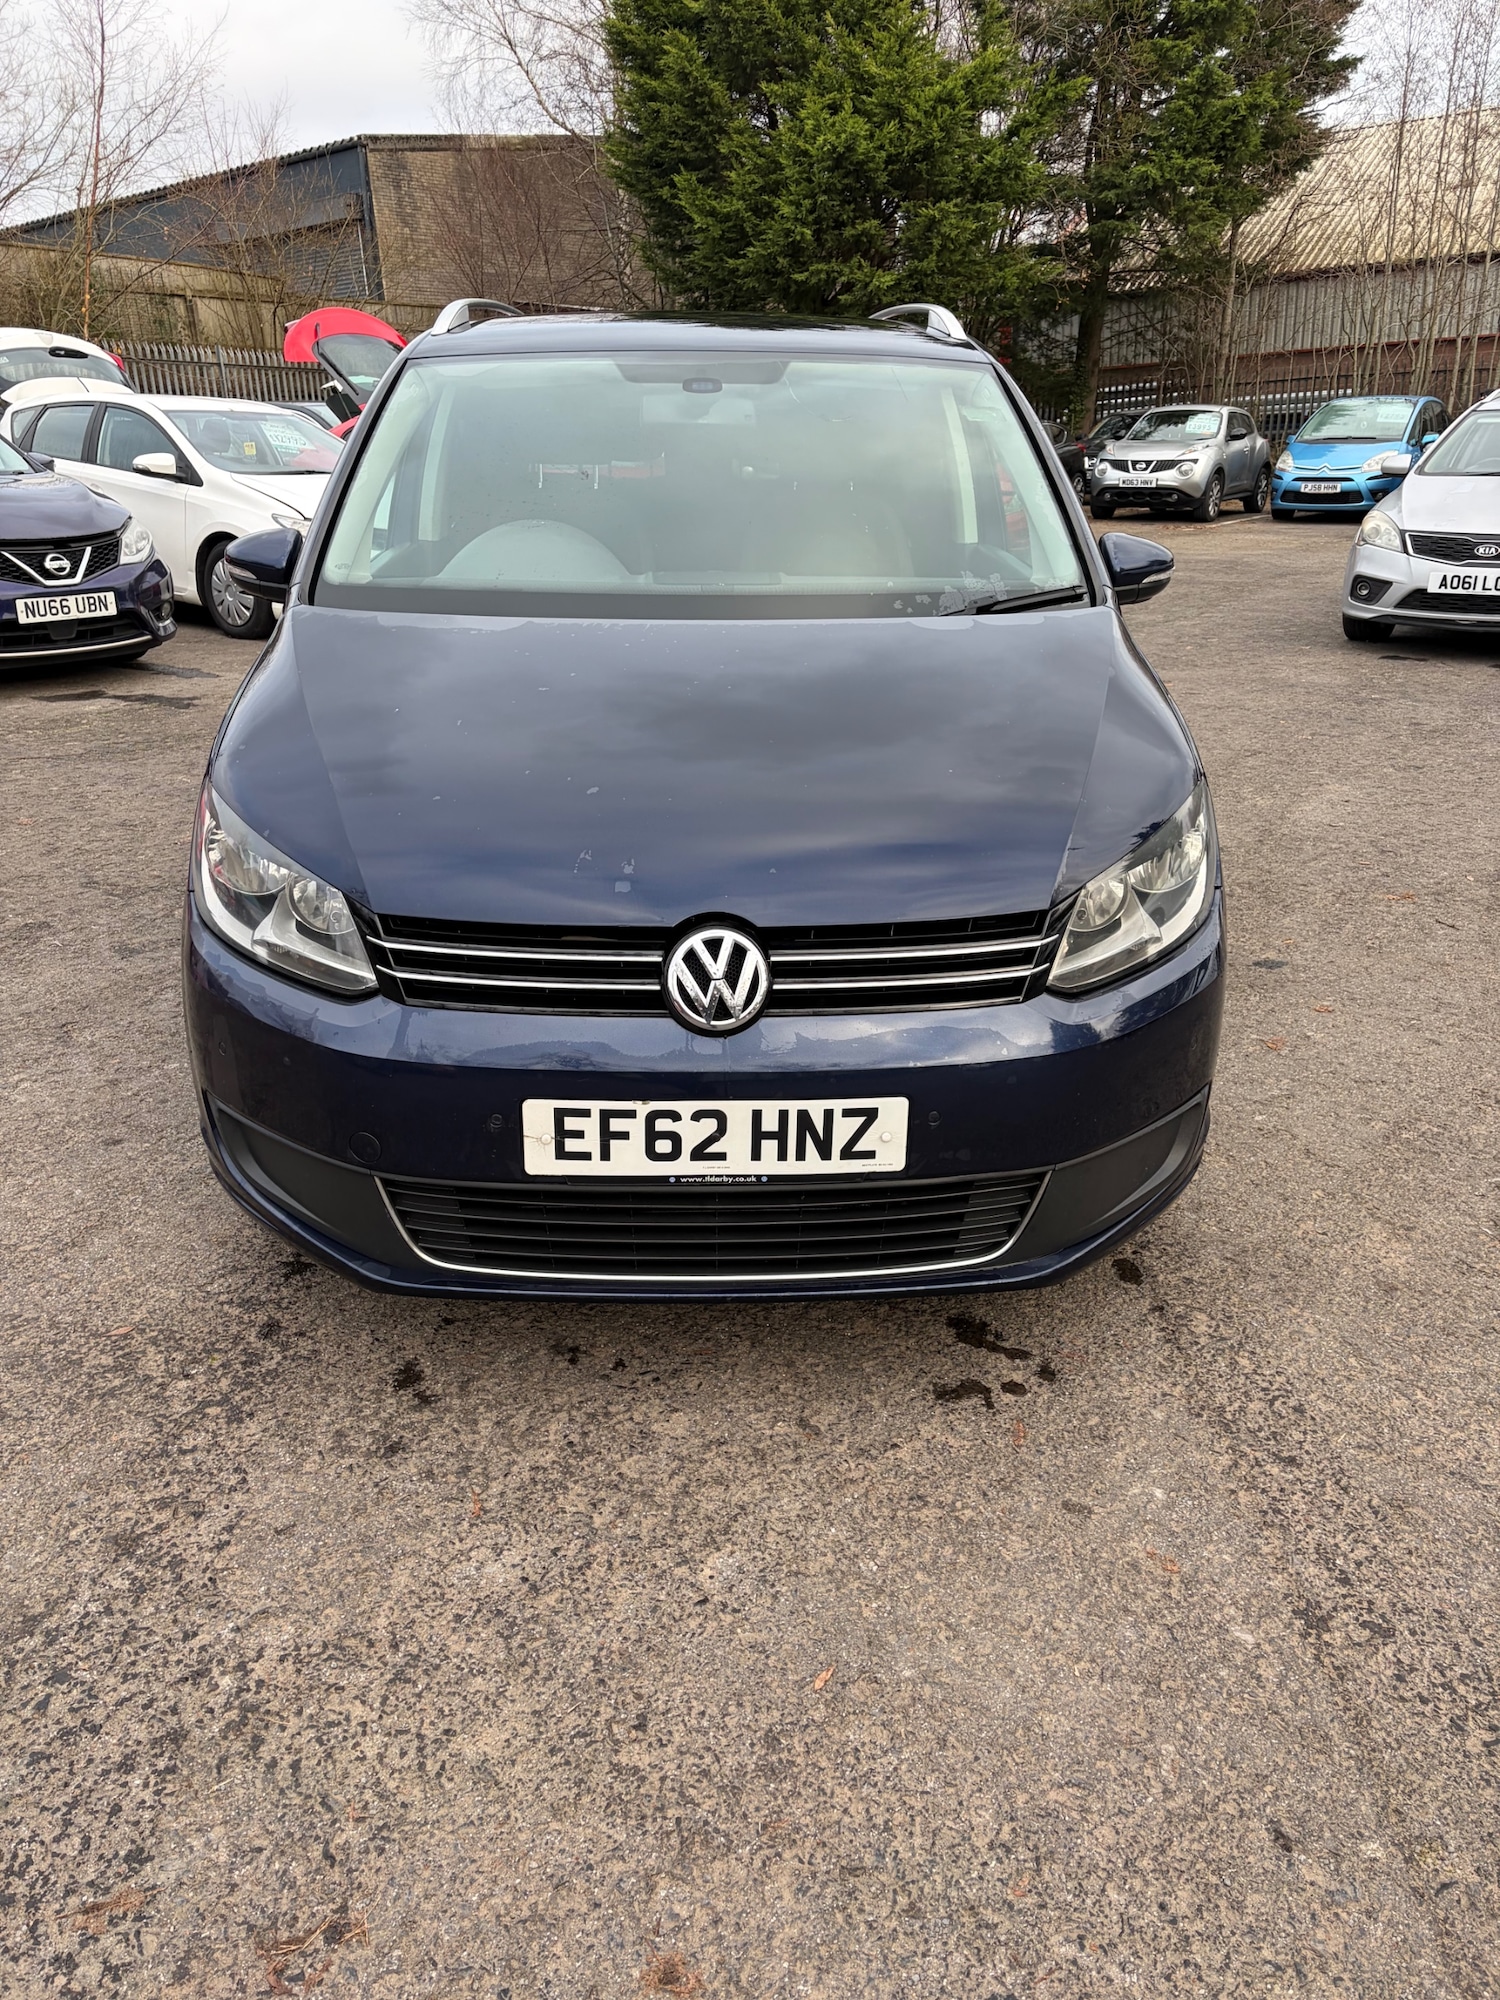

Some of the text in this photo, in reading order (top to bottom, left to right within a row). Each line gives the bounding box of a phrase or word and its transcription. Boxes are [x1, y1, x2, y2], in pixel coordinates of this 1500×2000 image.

[1478, 547, 1497, 555] KIA
[1439, 574, 1478, 591] AO61
[24, 595, 109, 619] NU66 UBN
[553, 1107, 880, 1162] EF62 HNZ
